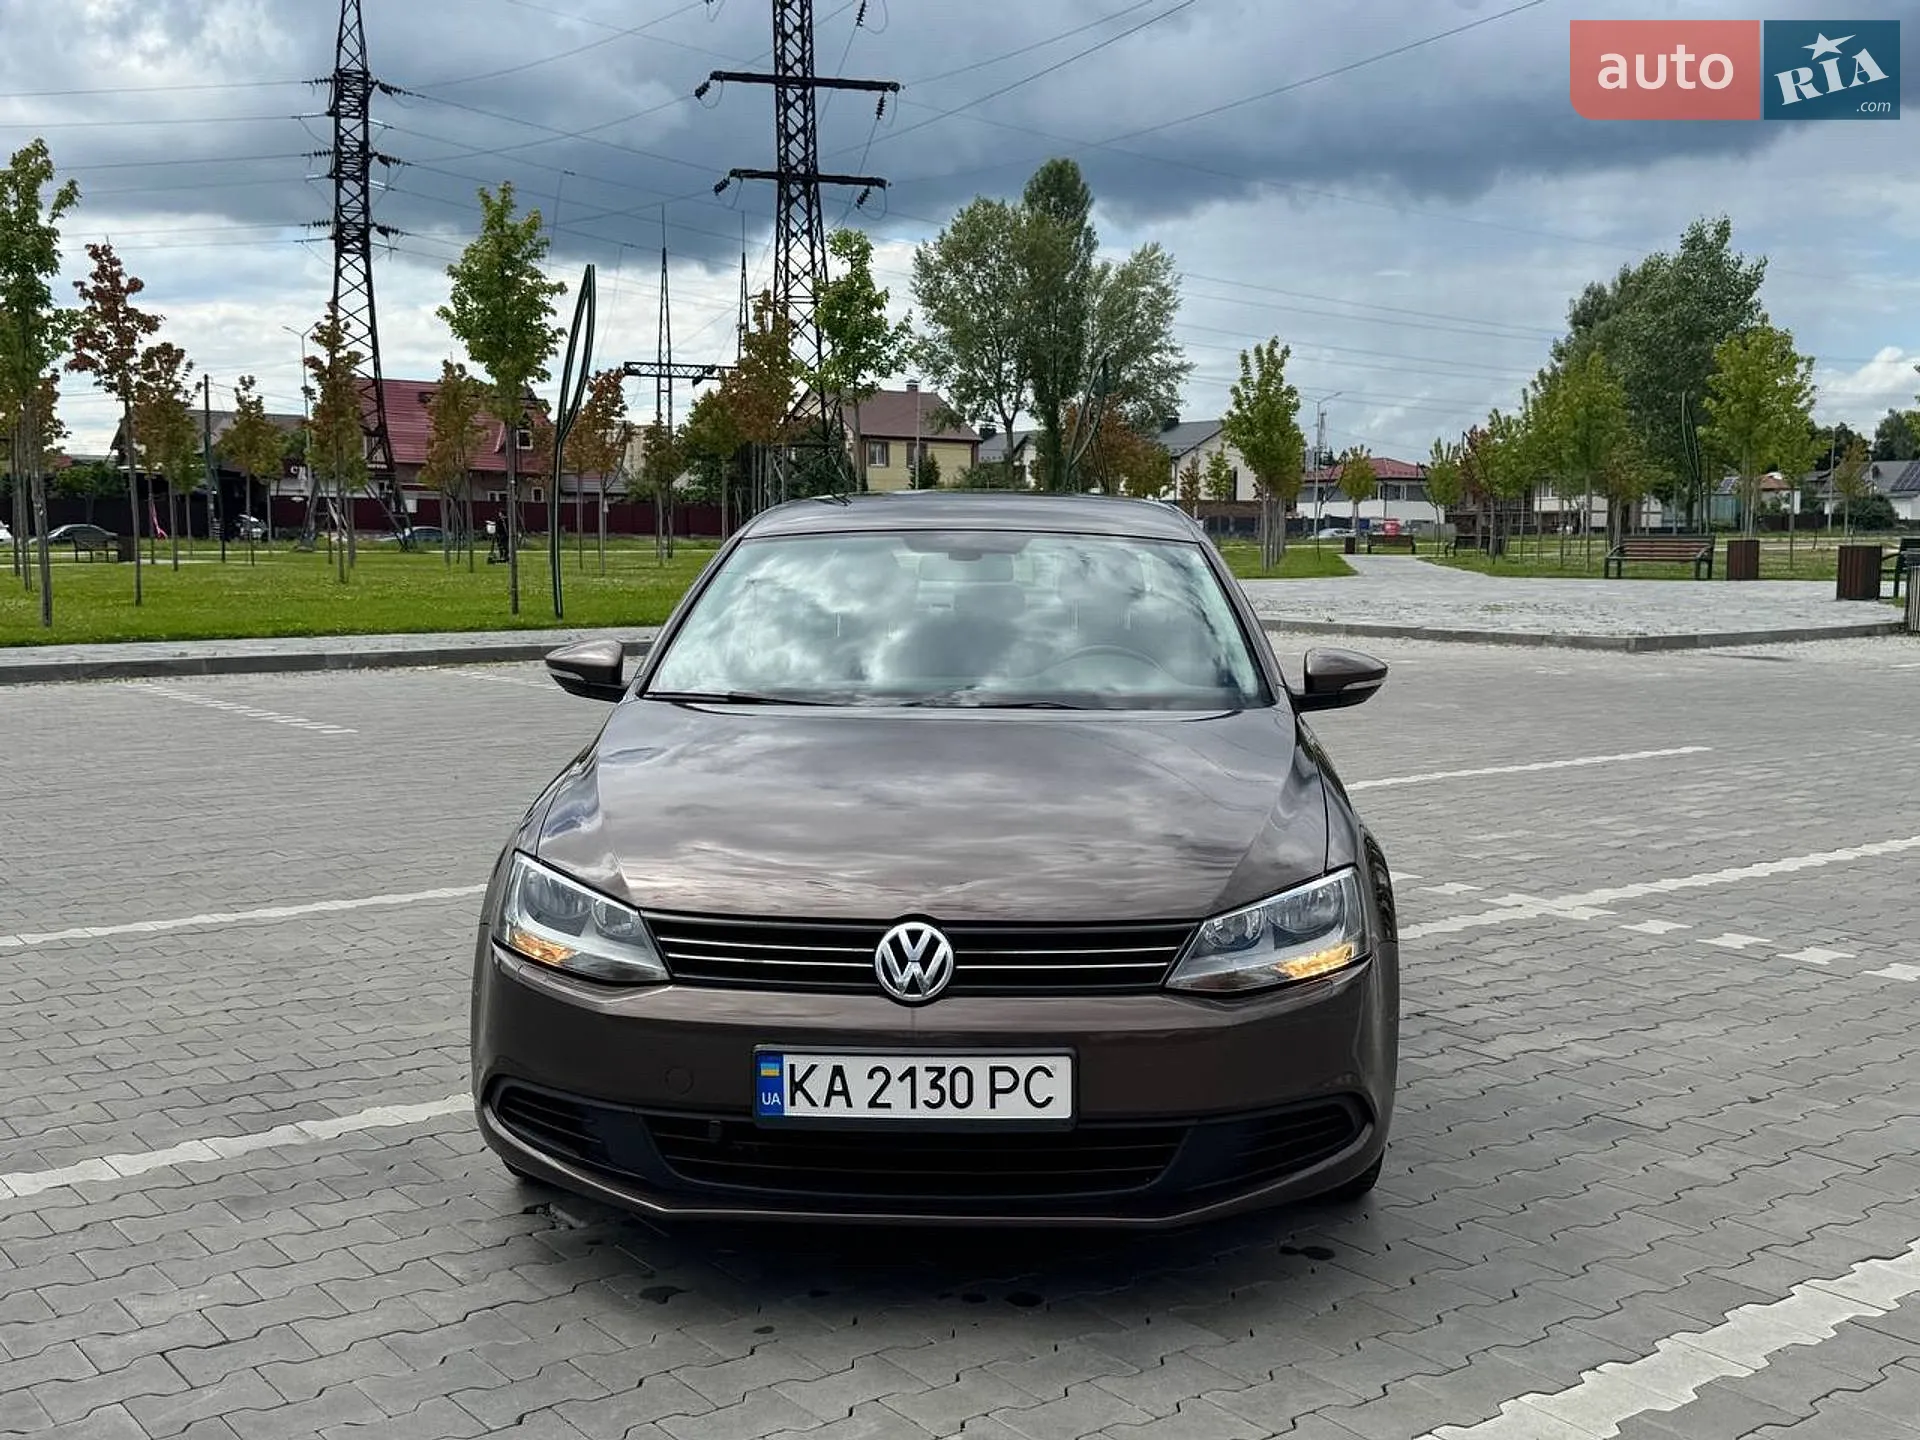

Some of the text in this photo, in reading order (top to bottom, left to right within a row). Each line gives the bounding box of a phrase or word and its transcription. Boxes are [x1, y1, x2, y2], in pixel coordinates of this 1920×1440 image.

[877, 923, 952, 1000] VW
[761, 1091, 782, 1106] UA
[788, 1063, 1054, 1110] KA 2130 PC
